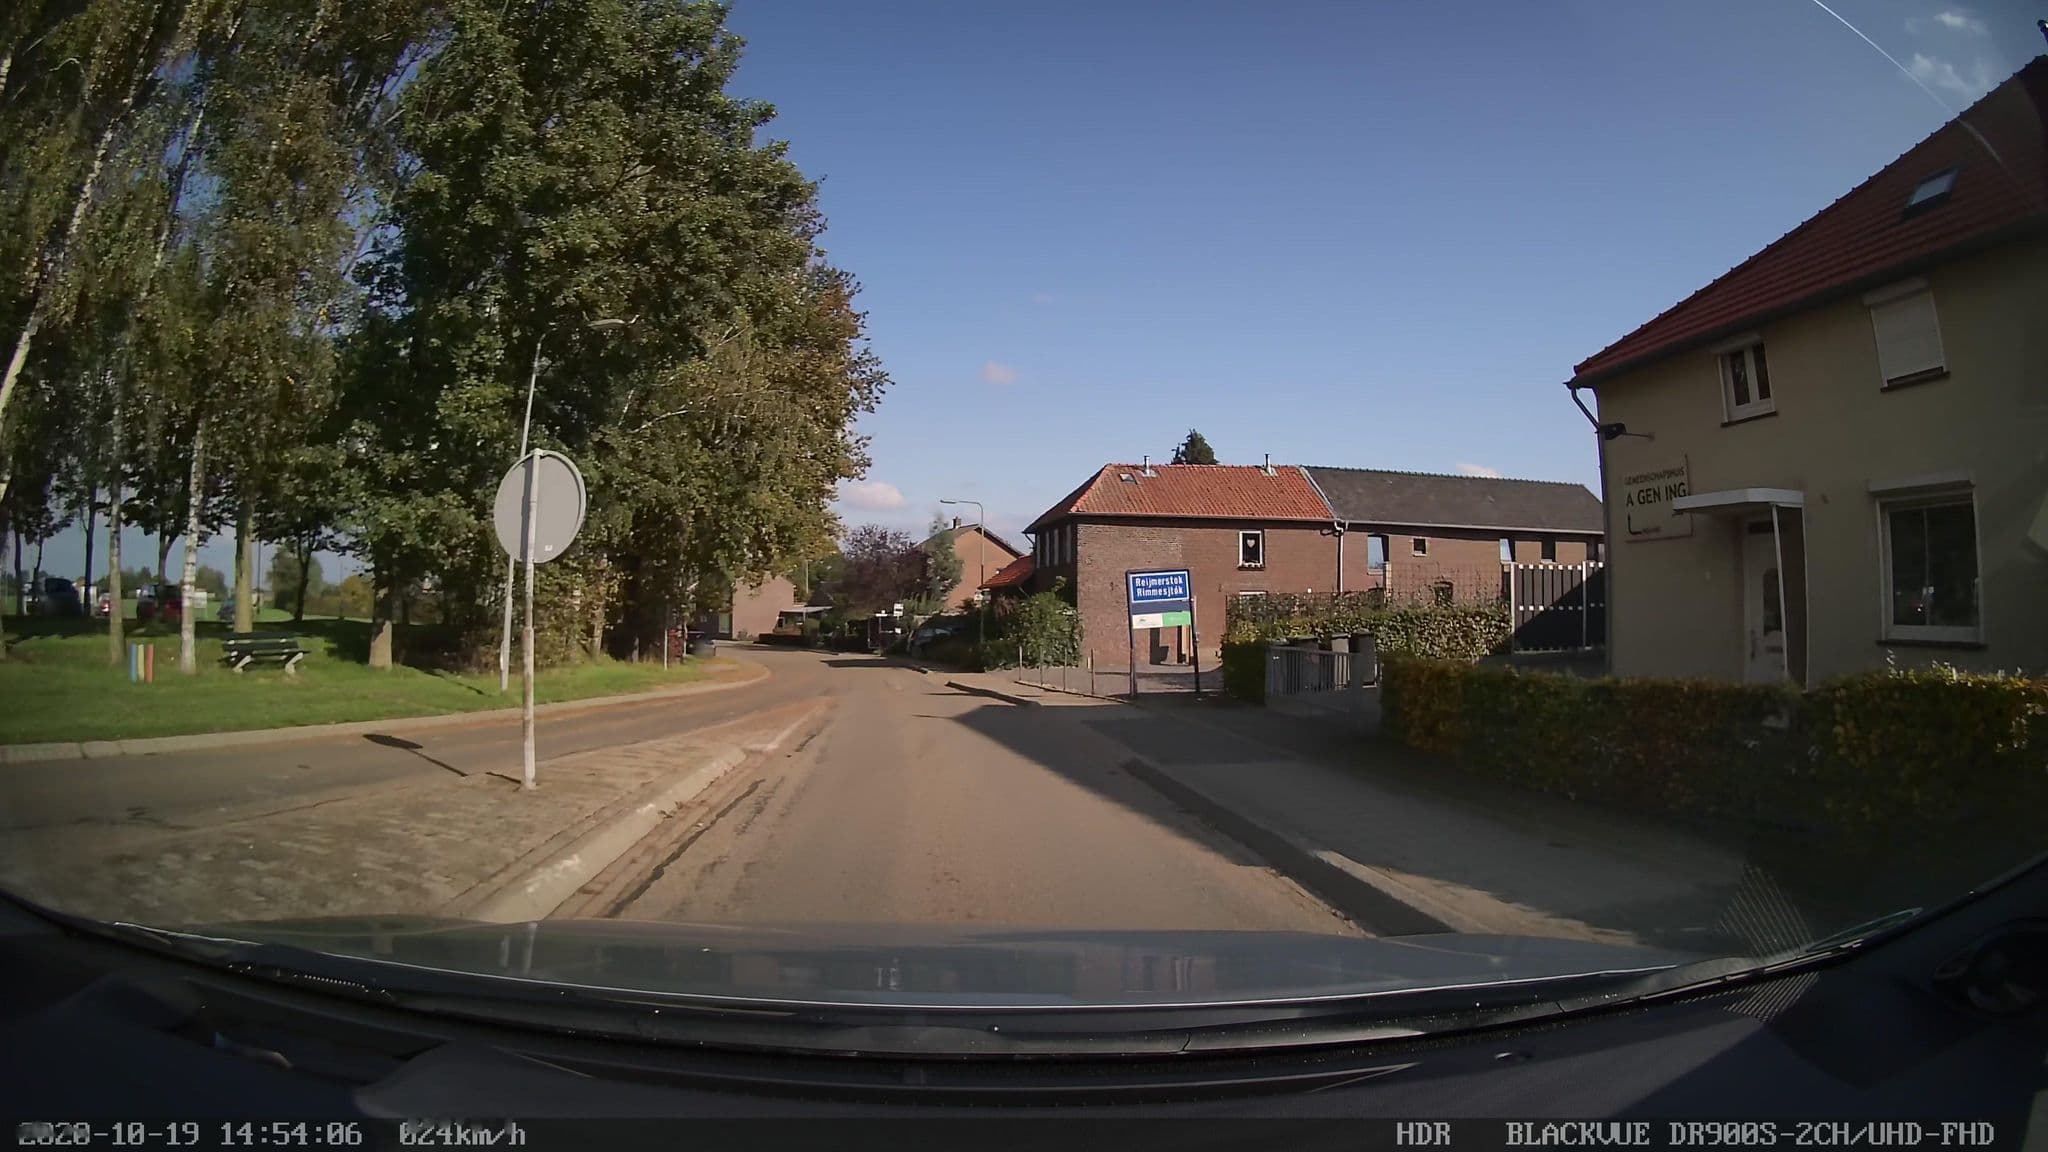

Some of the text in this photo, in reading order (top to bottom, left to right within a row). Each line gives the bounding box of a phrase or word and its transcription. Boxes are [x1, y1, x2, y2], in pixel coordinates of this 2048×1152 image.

[1626, 482, 1687, 507] A GEN ING
[1135, 576, 1184, 588] Reijmerstok
